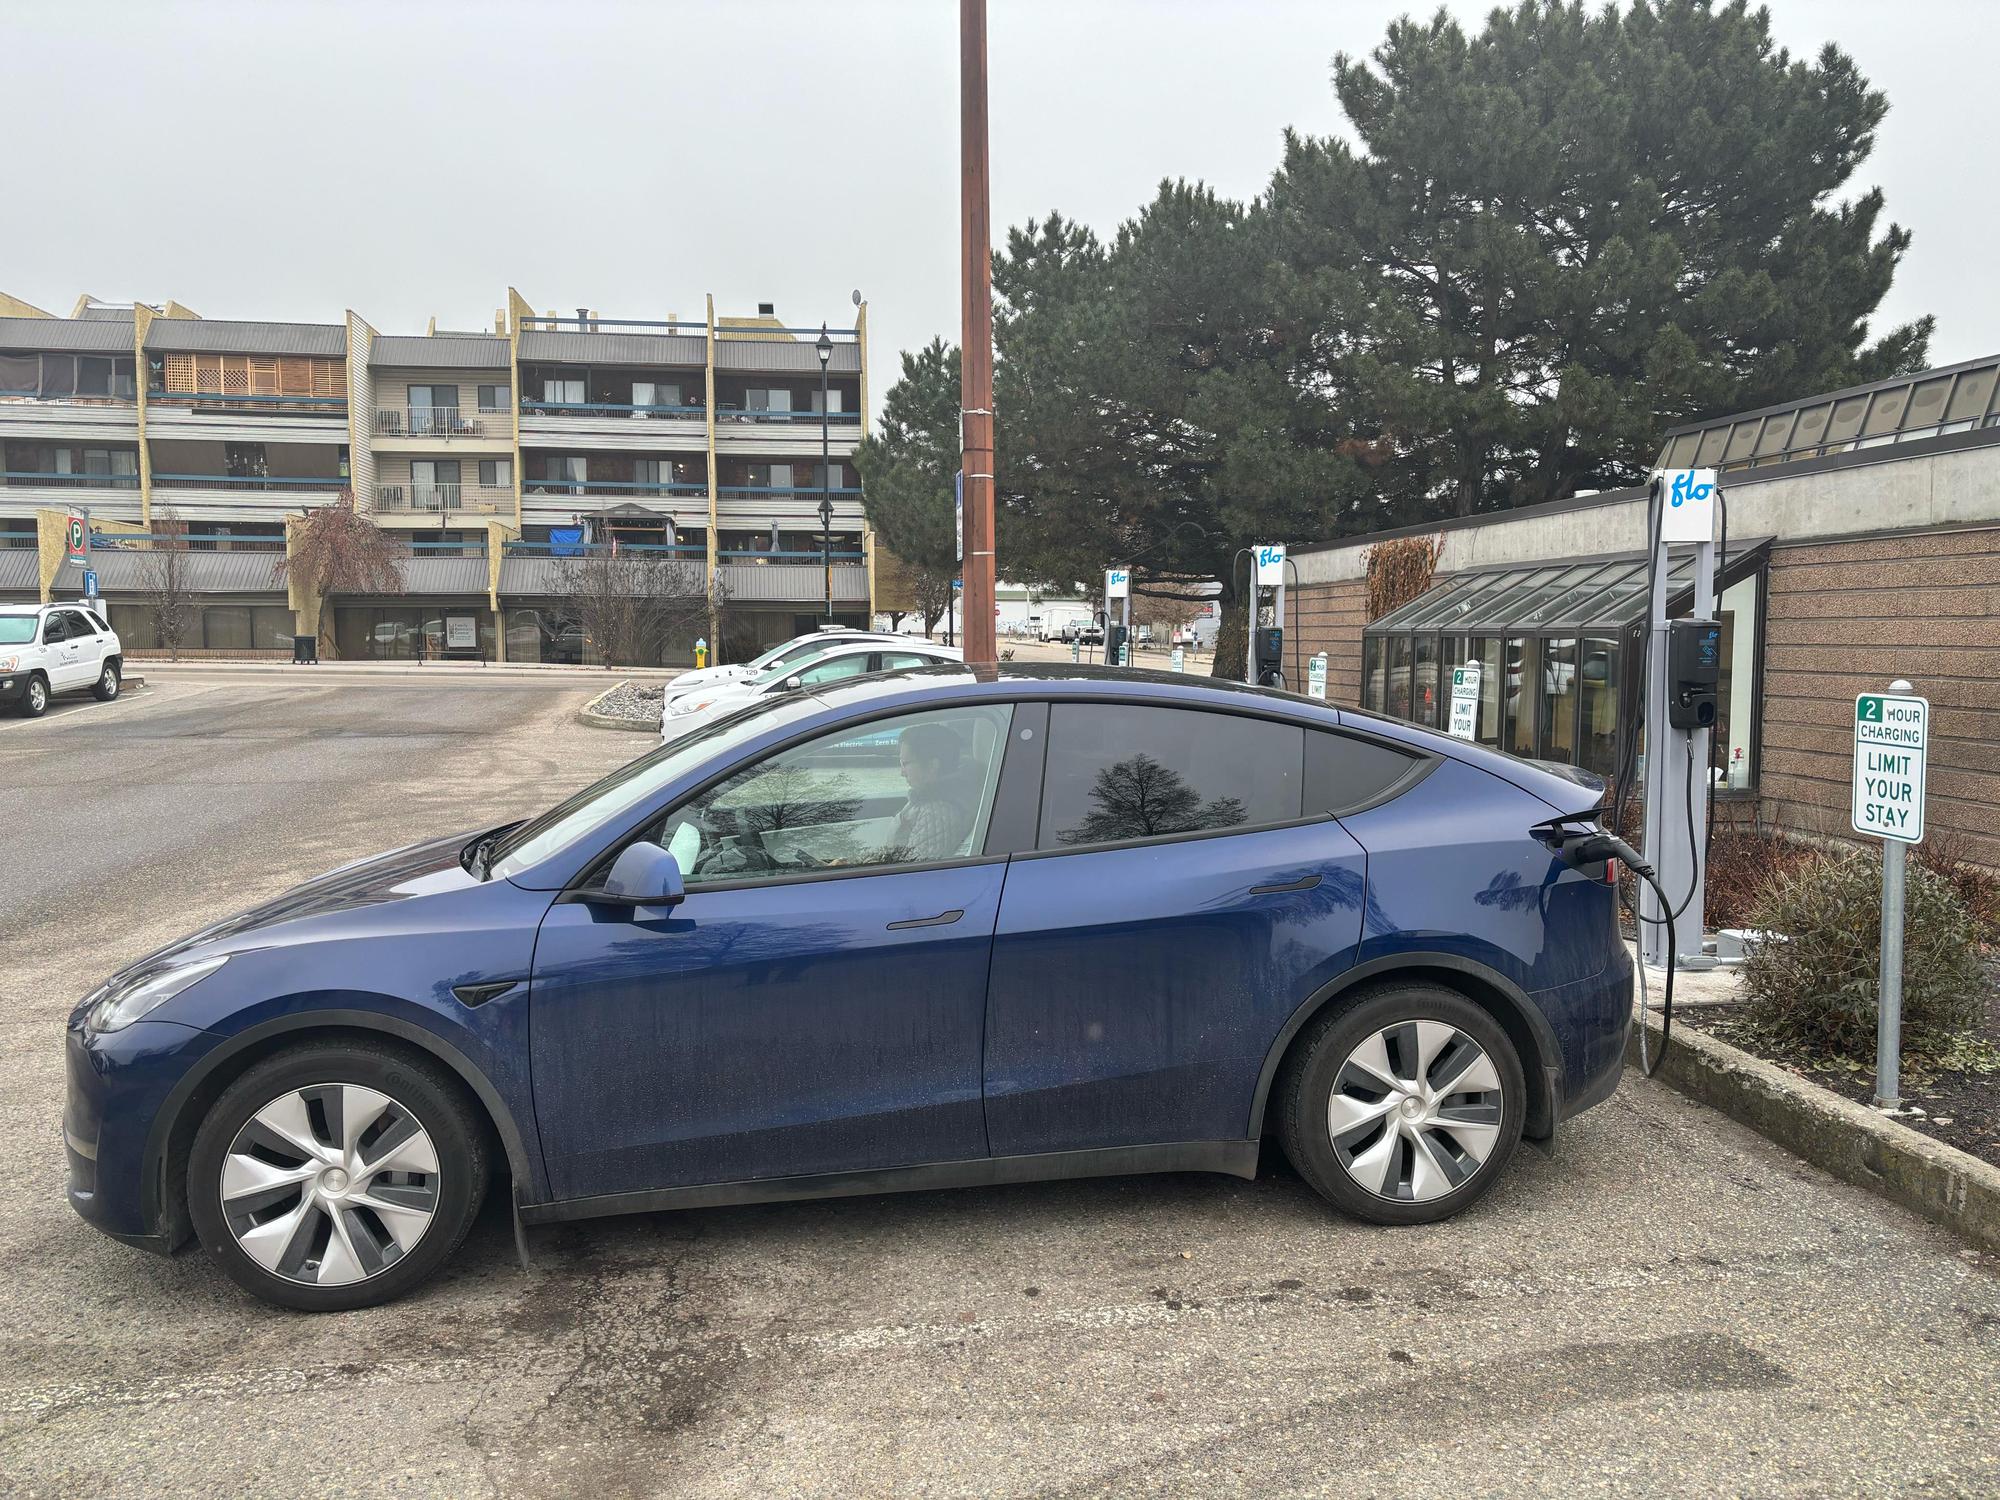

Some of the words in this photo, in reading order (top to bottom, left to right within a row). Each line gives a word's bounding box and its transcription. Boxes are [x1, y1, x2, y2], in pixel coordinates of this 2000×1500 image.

[1671, 470, 1714, 507] flo
[73, 524, 81, 546] P
[1260, 547, 1283, 567] flo
[1111, 572, 1127, 584] flo
[1456, 671, 1462, 684] 2
[1465, 676, 1477, 684] HOUR
[1454, 687, 1476, 696] CHARGING
[1455, 703, 1472, 716] LIMIT
[1865, 700, 1876, 719] 2
[1887, 708, 1920, 723] HOUR
[1453, 718, 1471, 732] YOUR
[1861, 725, 1920, 743] CHARGING
[1868, 752, 1911, 775] LIMIT
[1865, 777, 1912, 802] YOUR
[1866, 803, 1909, 828] STAY
